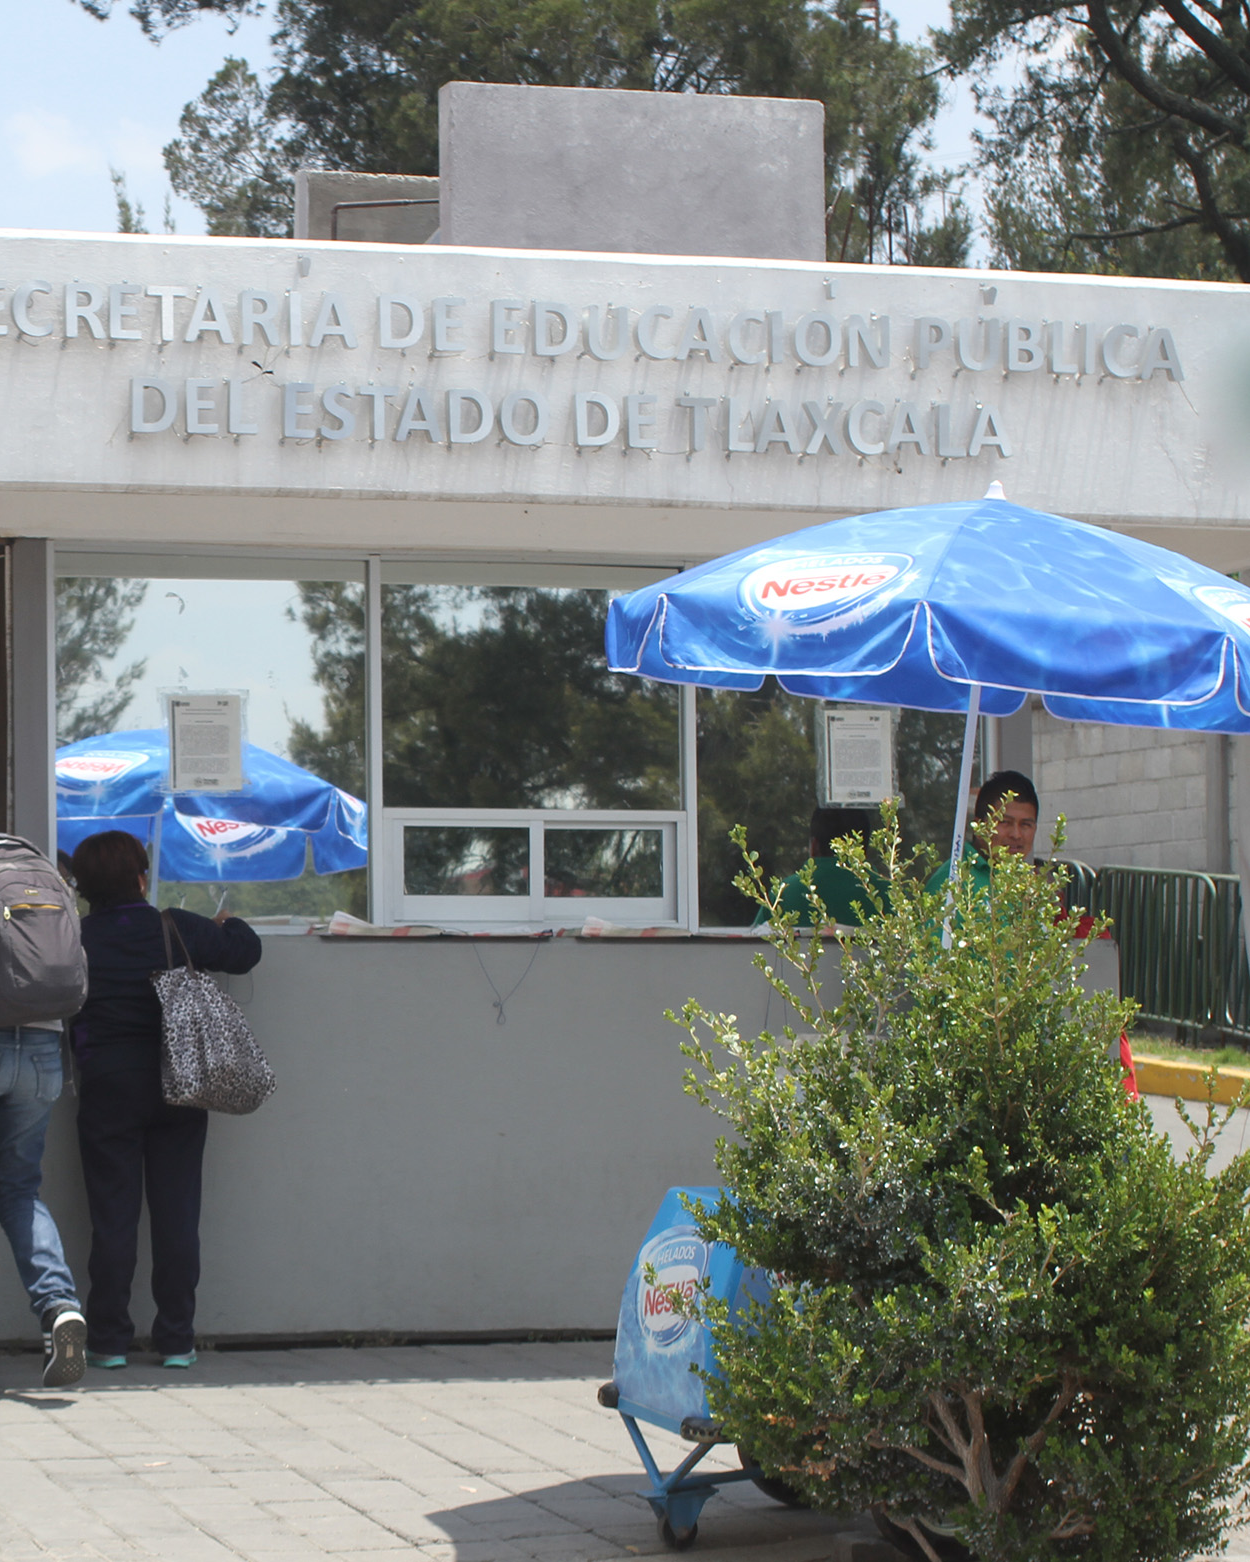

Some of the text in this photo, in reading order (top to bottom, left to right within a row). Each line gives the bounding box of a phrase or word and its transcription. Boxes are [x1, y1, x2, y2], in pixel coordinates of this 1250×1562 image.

[379, 295, 466, 352] DE
[491, 277, 891, 369] EDUCACIÓN
[915, 283, 1187, 382] PÚBLICA
[128, 376, 1014, 458] DEL ESTADO DE TLAXCALA
[656, 1245, 696, 1267] HELADOS
